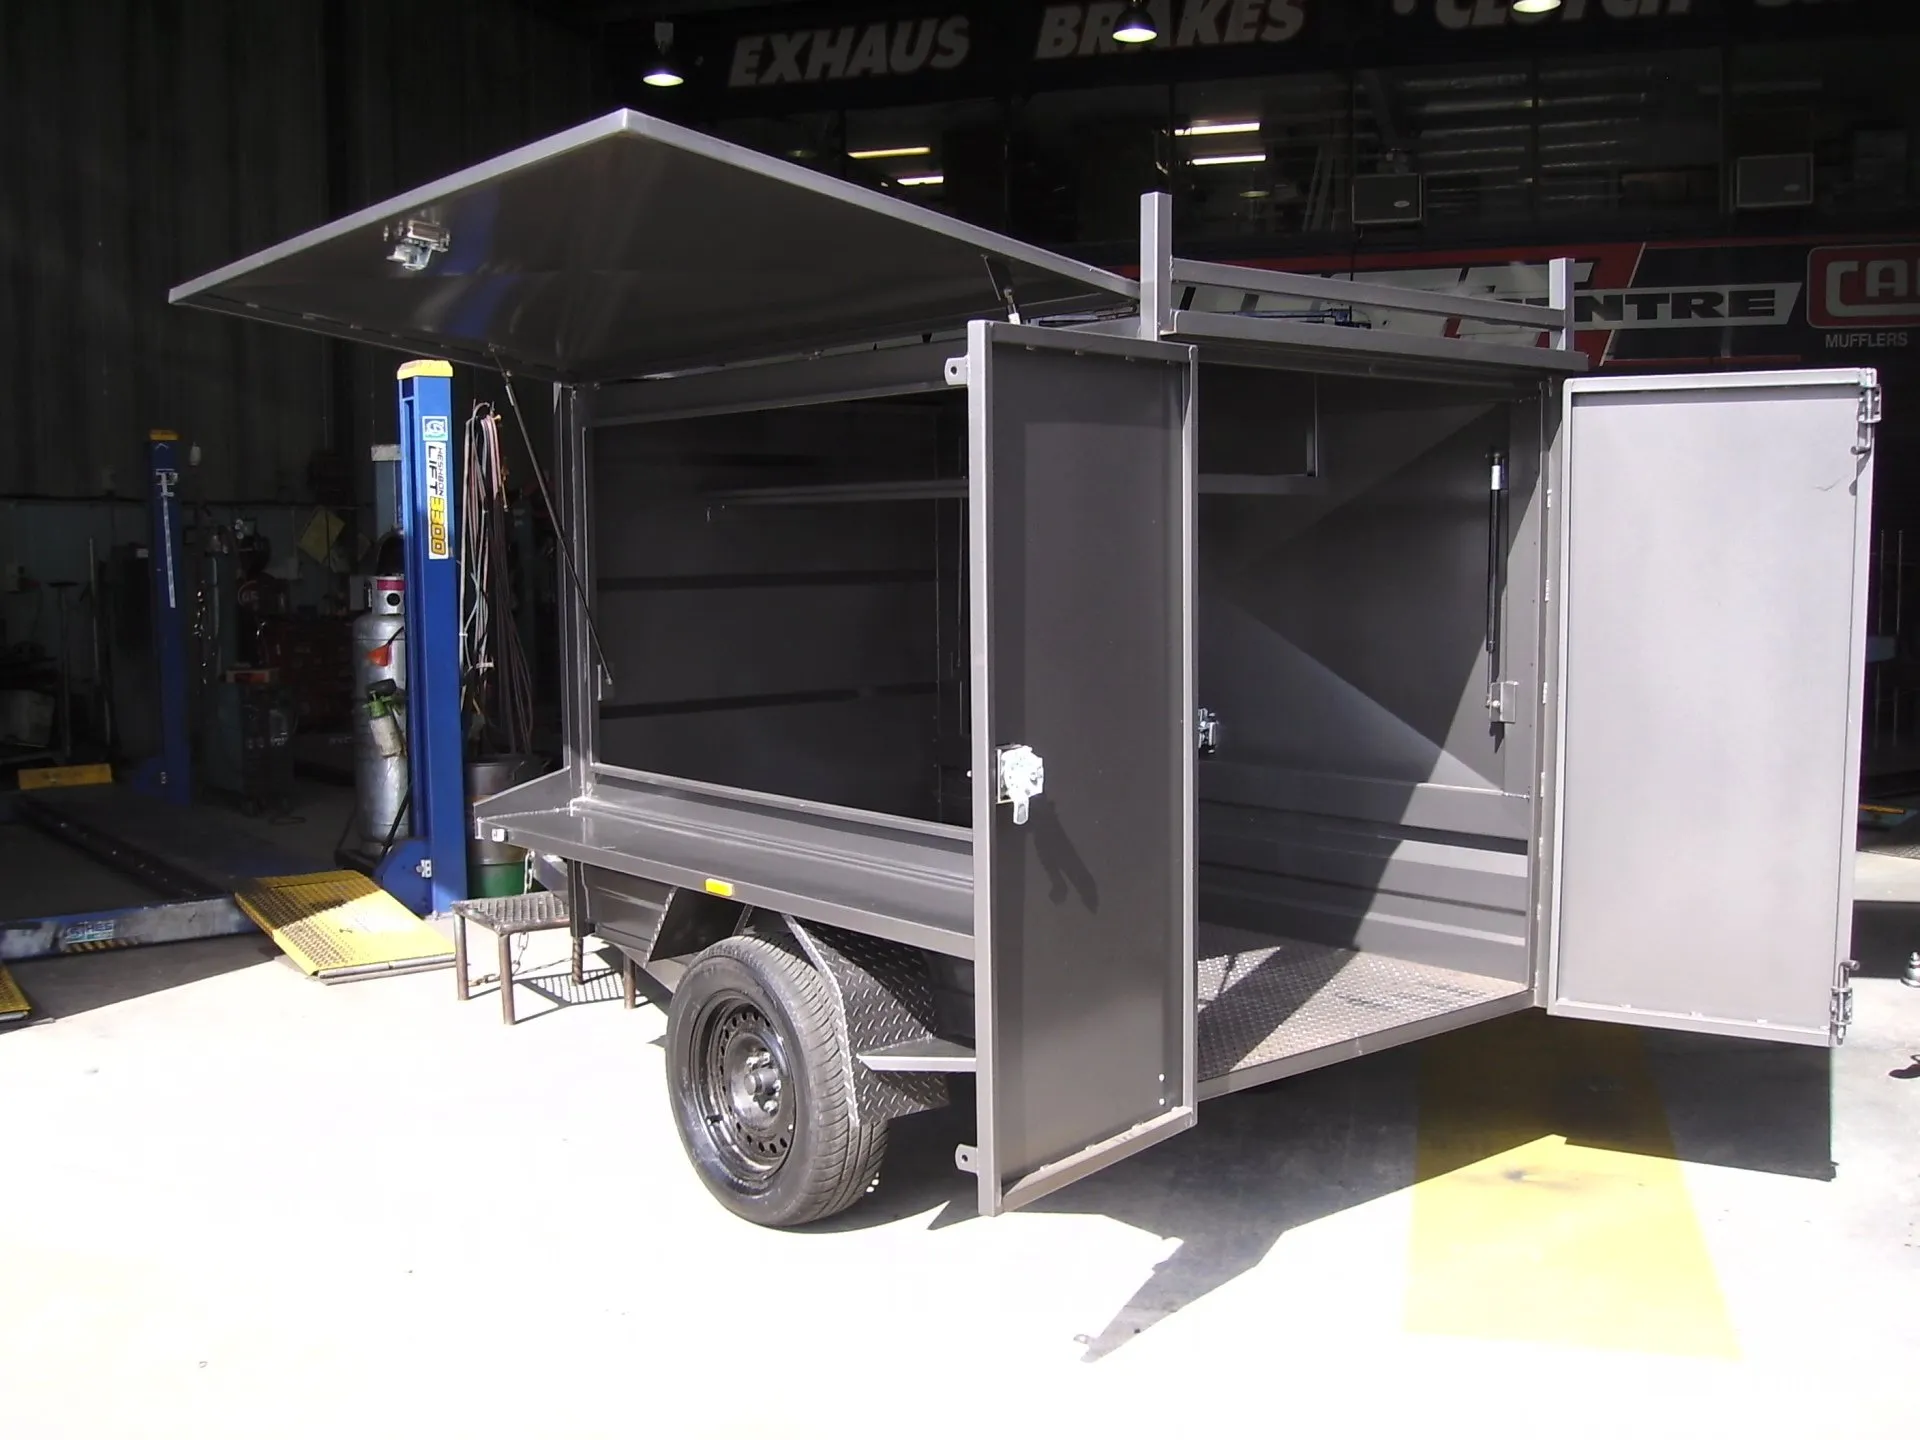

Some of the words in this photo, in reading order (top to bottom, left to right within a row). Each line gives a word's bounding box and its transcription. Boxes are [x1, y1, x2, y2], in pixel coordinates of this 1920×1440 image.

[727, 14, 970, 88] EXHAUS
[1825, 261, 1920, 317] CA
[1825, 331, 1908, 349] MUFFLERS
[429, 446, 438, 495] LIFT
[430, 496, 446, 555] 3300
